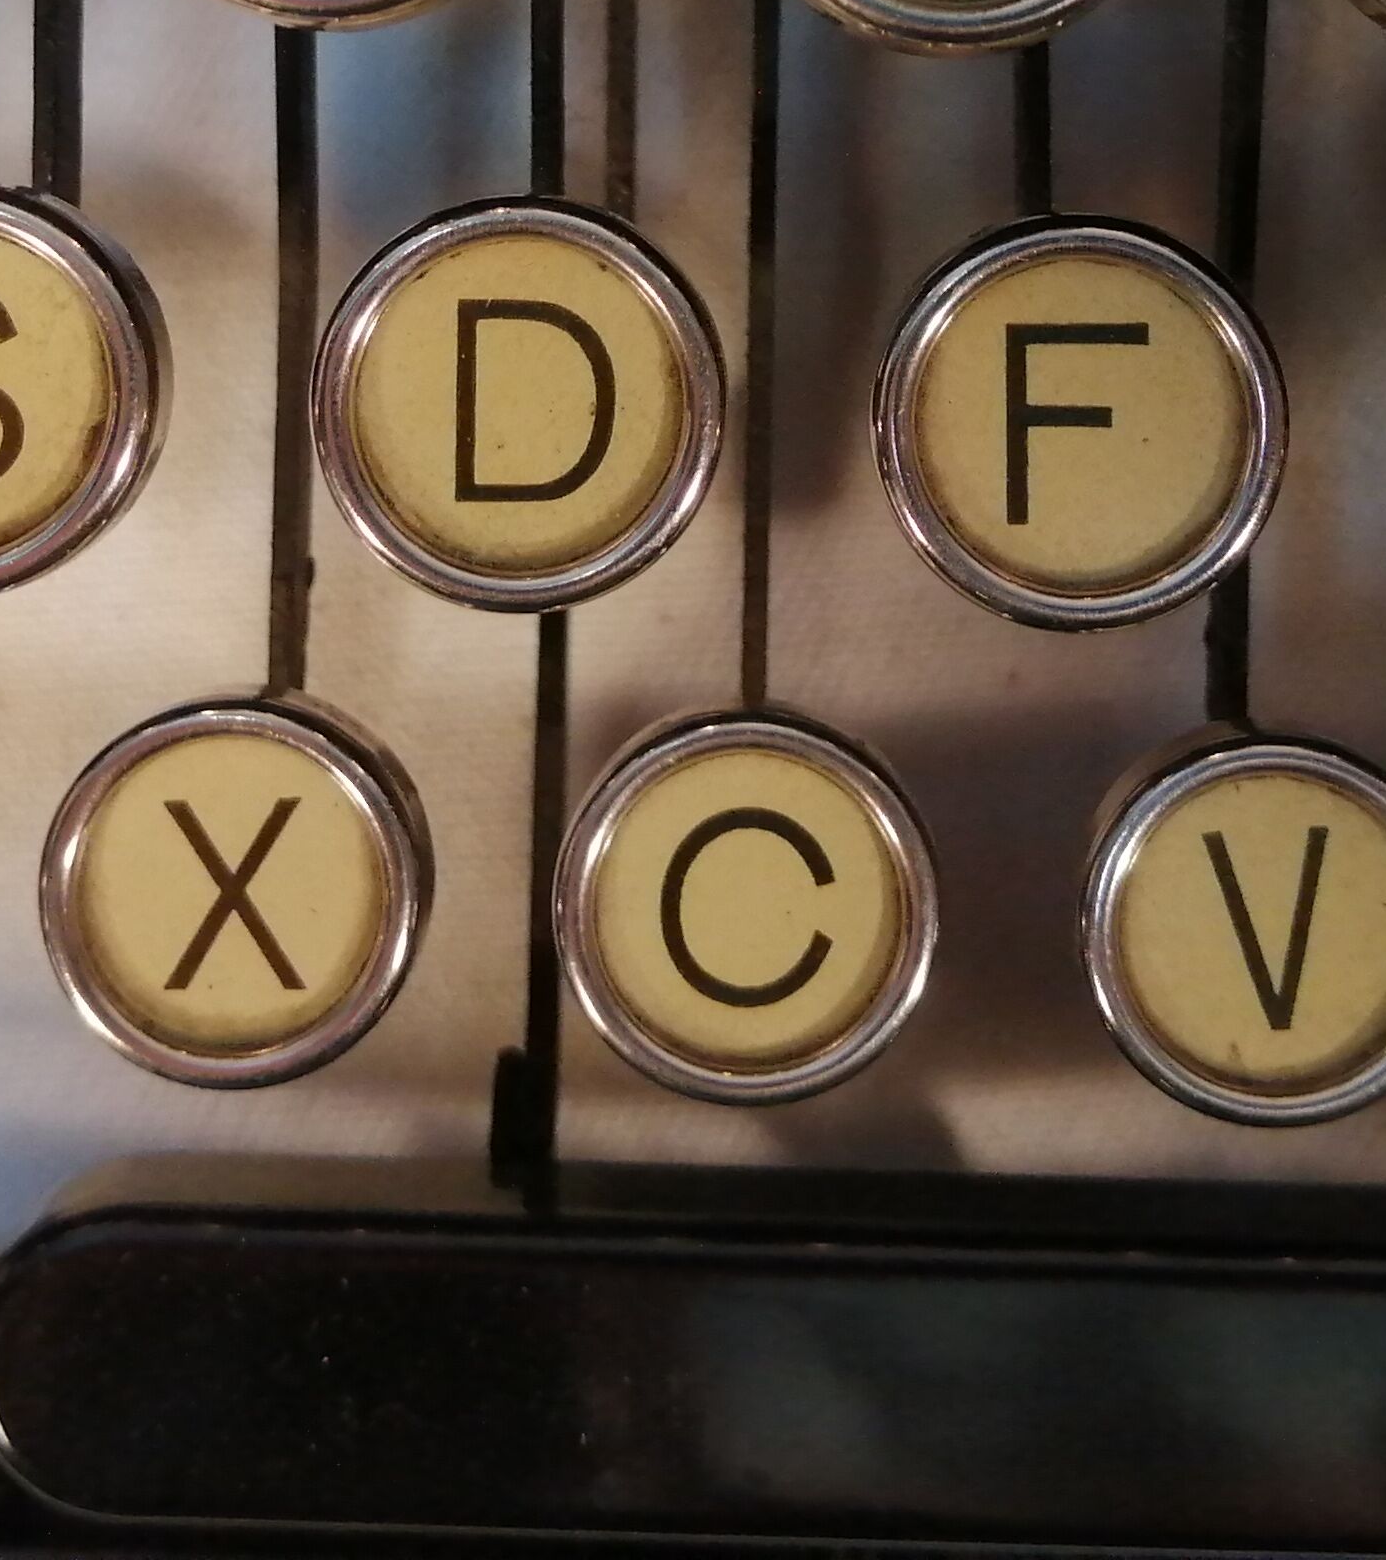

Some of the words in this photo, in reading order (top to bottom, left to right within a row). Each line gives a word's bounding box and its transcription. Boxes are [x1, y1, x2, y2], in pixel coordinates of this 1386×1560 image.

[455, 299, 614, 504] D
[1006, 322, 1149, 526] F
[163, 797, 305, 993] X
[660, 807, 835, 1008] C
[1202, 826, 1329, 1031] V
